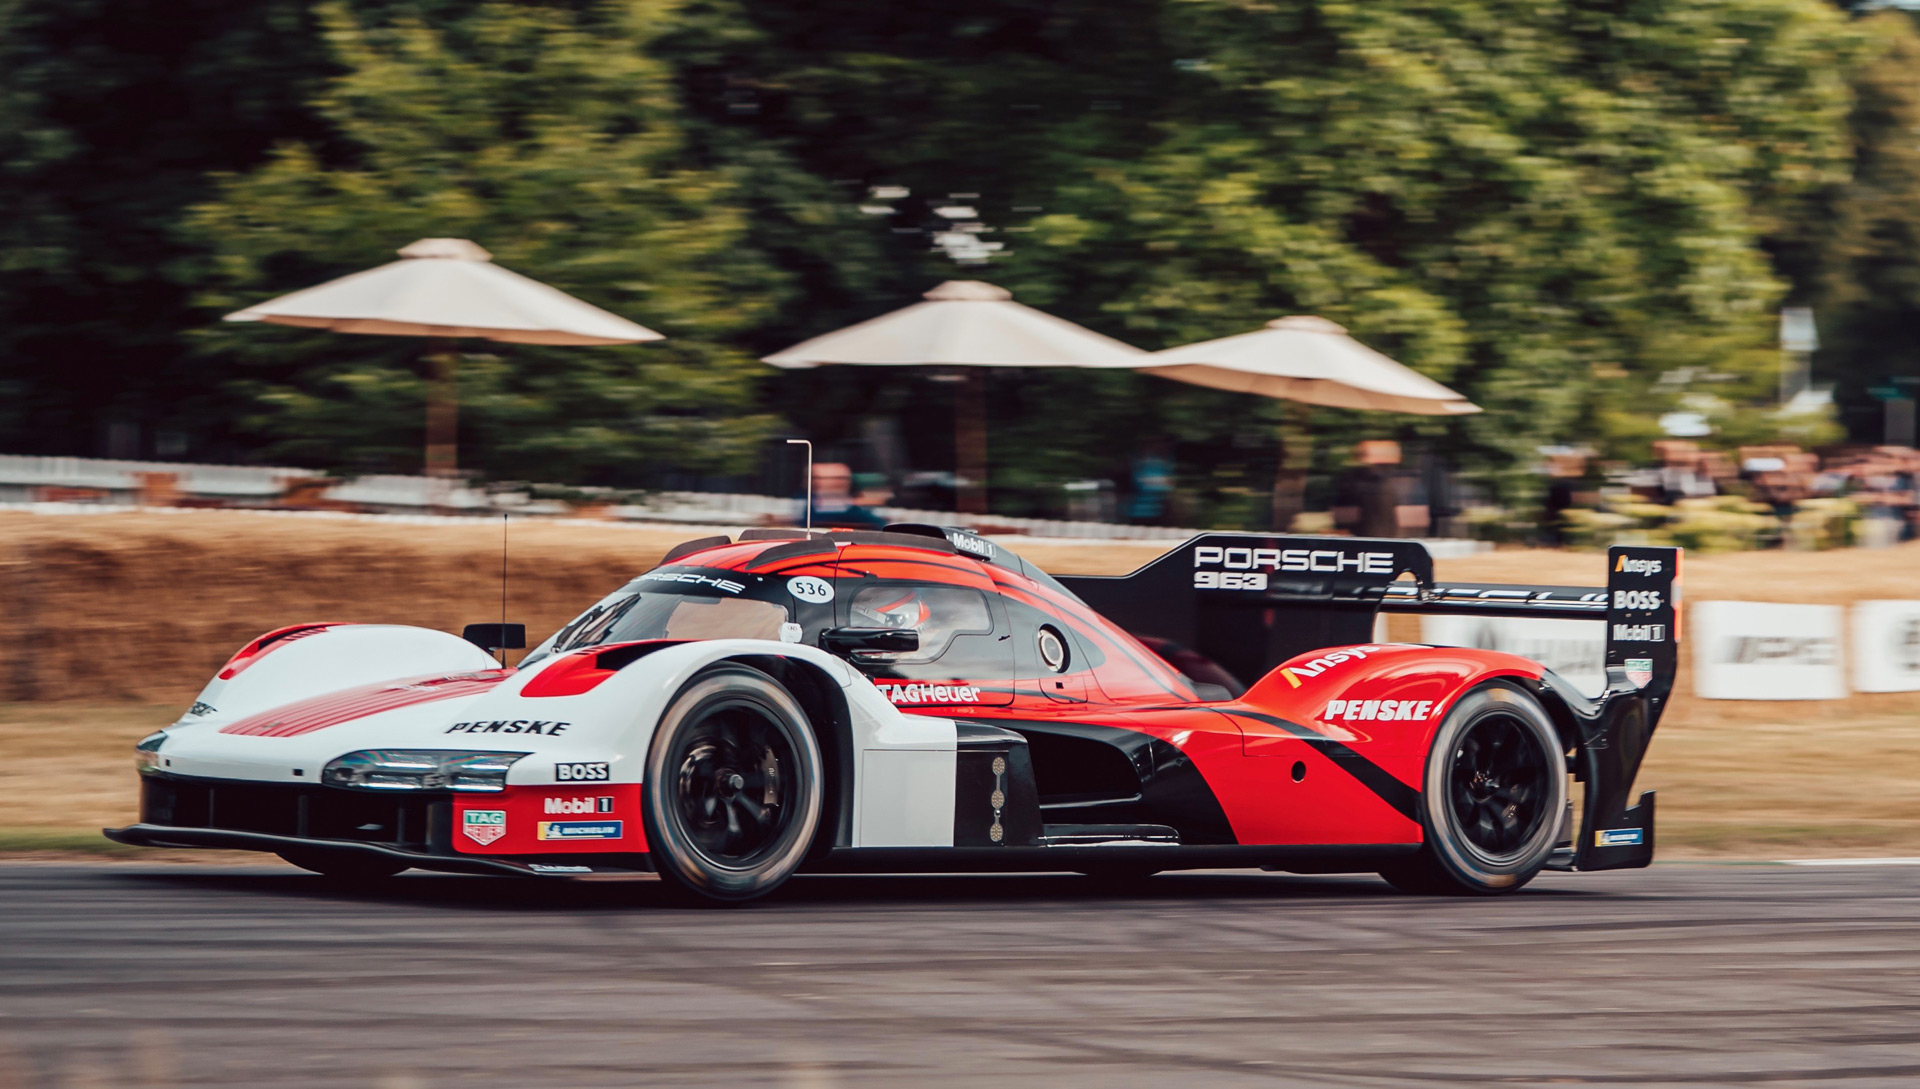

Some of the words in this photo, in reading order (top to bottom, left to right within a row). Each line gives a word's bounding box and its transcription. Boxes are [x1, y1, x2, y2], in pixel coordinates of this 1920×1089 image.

[953, 532, 985, 554] Mobil
[1194, 546, 1394, 574] PORSCHE
[795, 582, 827, 597] 536
[1193, 571, 1268, 591] 963
[1613, 590, 1661, 610] BOSS
[1613, 623, 1650, 641] Mobil
[1280, 645, 1379, 689] Ansys
[1324, 699, 1433, 721] PENSKE
[445, 719, 572, 737] PENSKE
[558, 763, 608, 780] BOSS
[544, 797, 595, 814] Mobil
[467, 812, 503, 825] TAG
